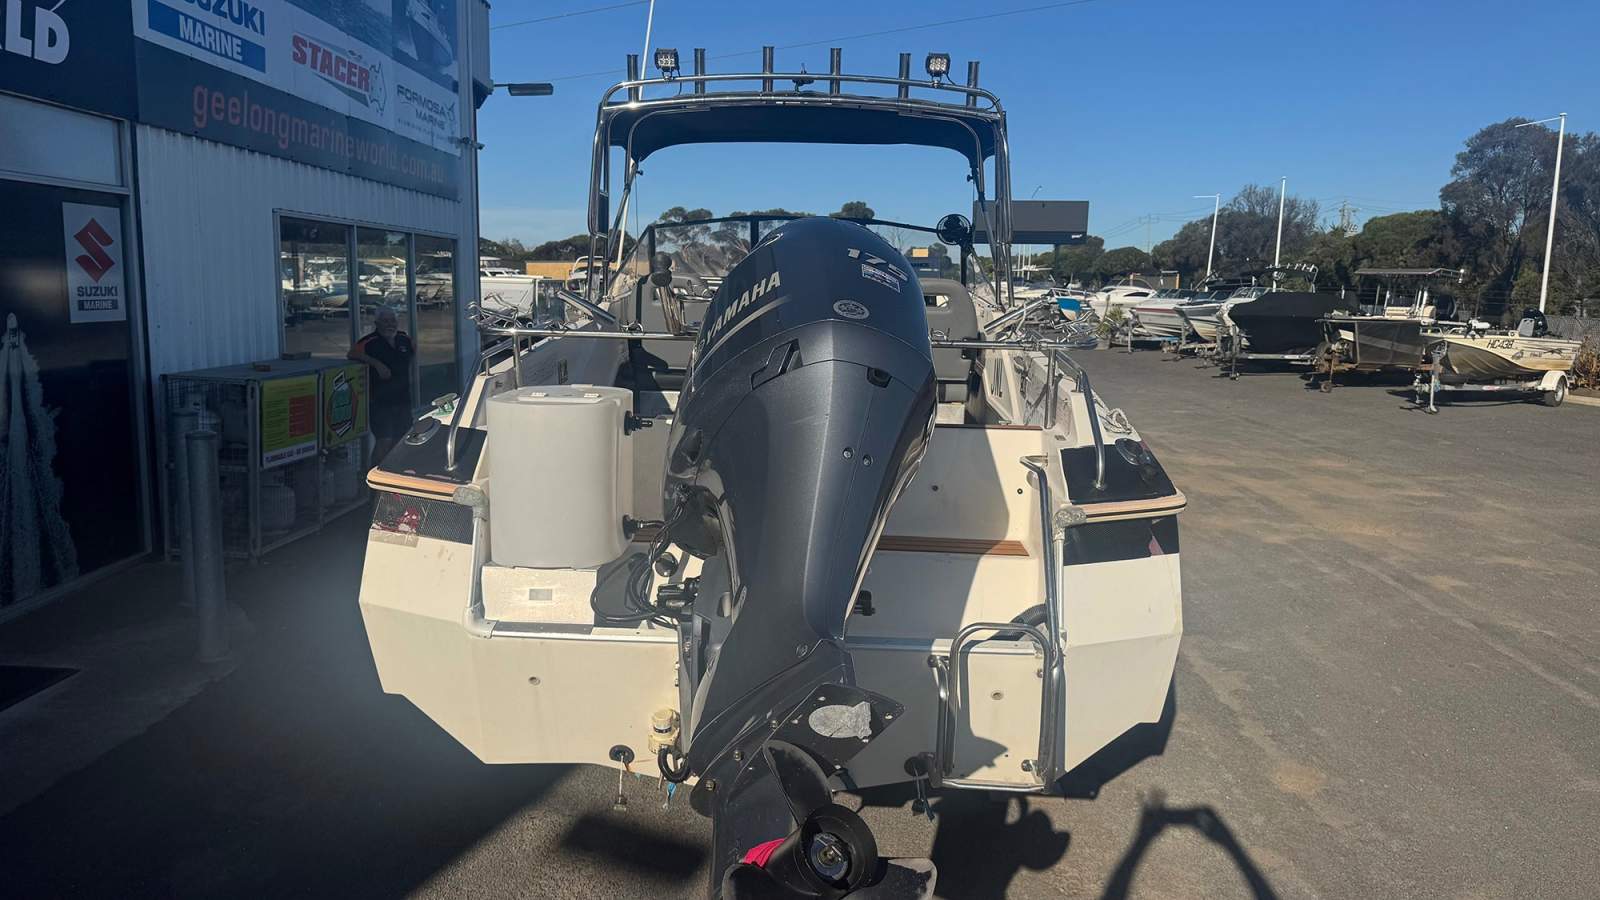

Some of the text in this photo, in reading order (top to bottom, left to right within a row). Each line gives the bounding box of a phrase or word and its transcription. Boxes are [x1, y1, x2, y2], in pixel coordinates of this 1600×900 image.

[0, 0, 70, 64] LD
[184, 0, 265, 36] ZUKI
[179, 13, 243, 61] MARINE
[291, 34, 370, 93] STACER
[397, 84, 448, 120] FORMOSA
[415, 109, 445, 131] MARINE
[192, 84, 446, 183] geelongmarineworld.com.au
[847, 247, 908, 281] 175
[77, 286, 118, 297] SUZUKI
[83, 300, 113, 309] MARINE
[705, 271, 781, 345] YAMAHA
